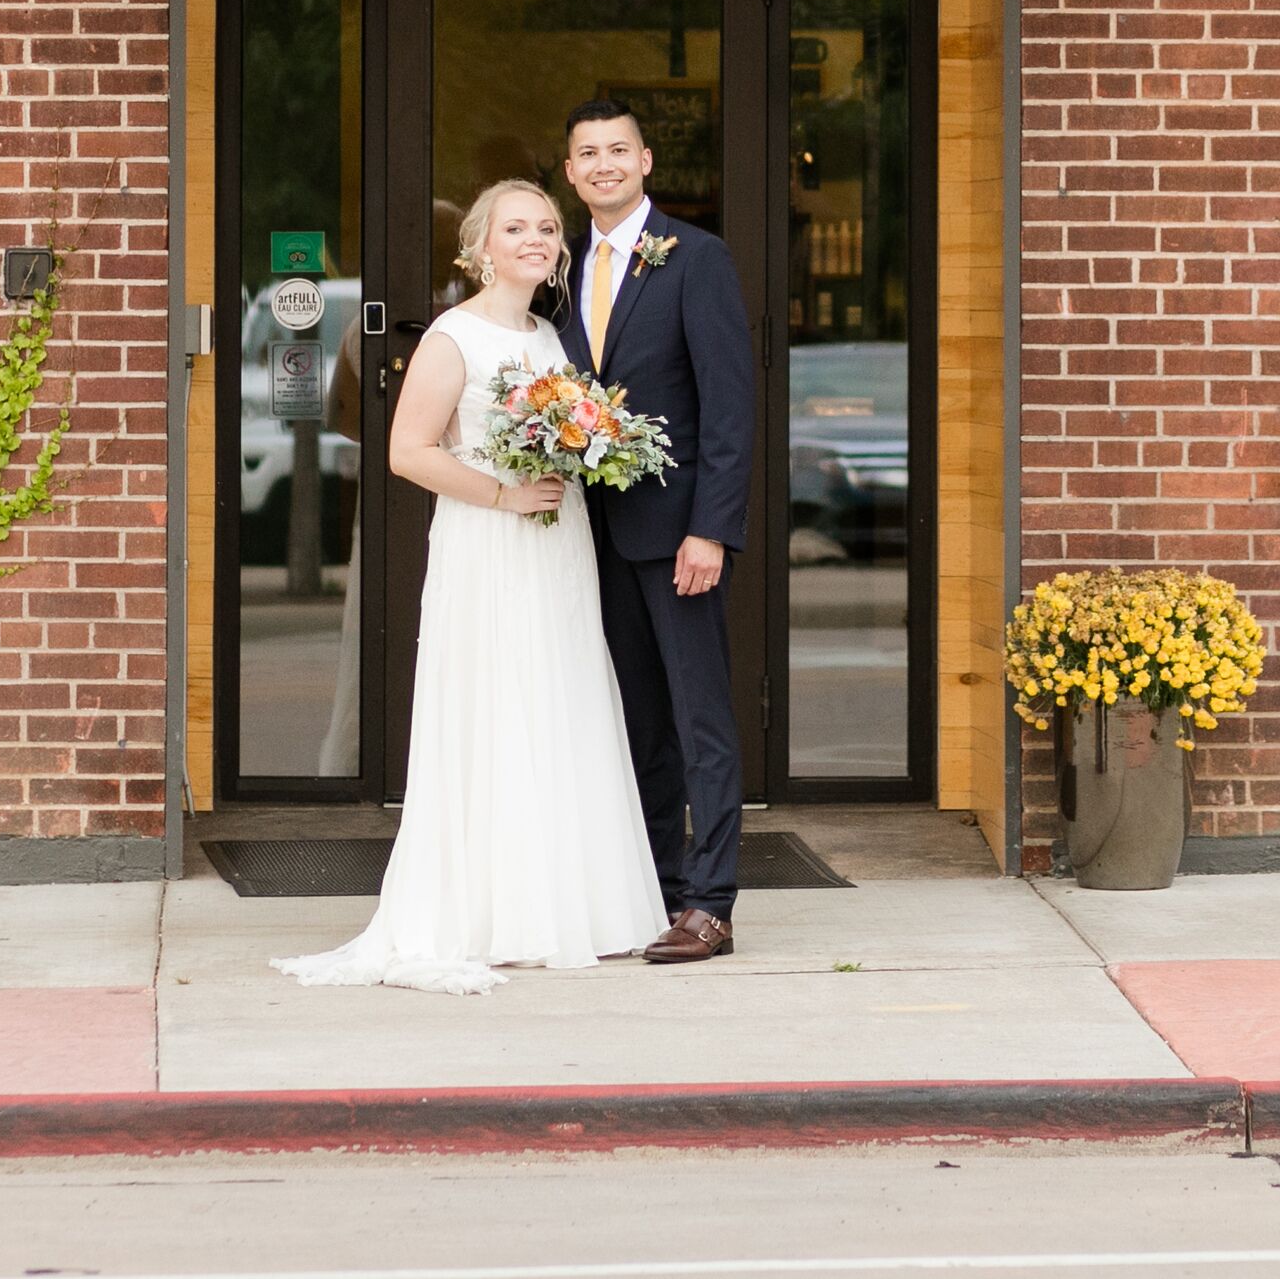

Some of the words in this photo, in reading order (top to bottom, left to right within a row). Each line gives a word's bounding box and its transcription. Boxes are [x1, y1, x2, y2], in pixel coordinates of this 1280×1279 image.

[278, 292, 317, 304] artFULL
[278, 304, 292, 312] EAU
[293, 304, 317, 312] CLAIRE
